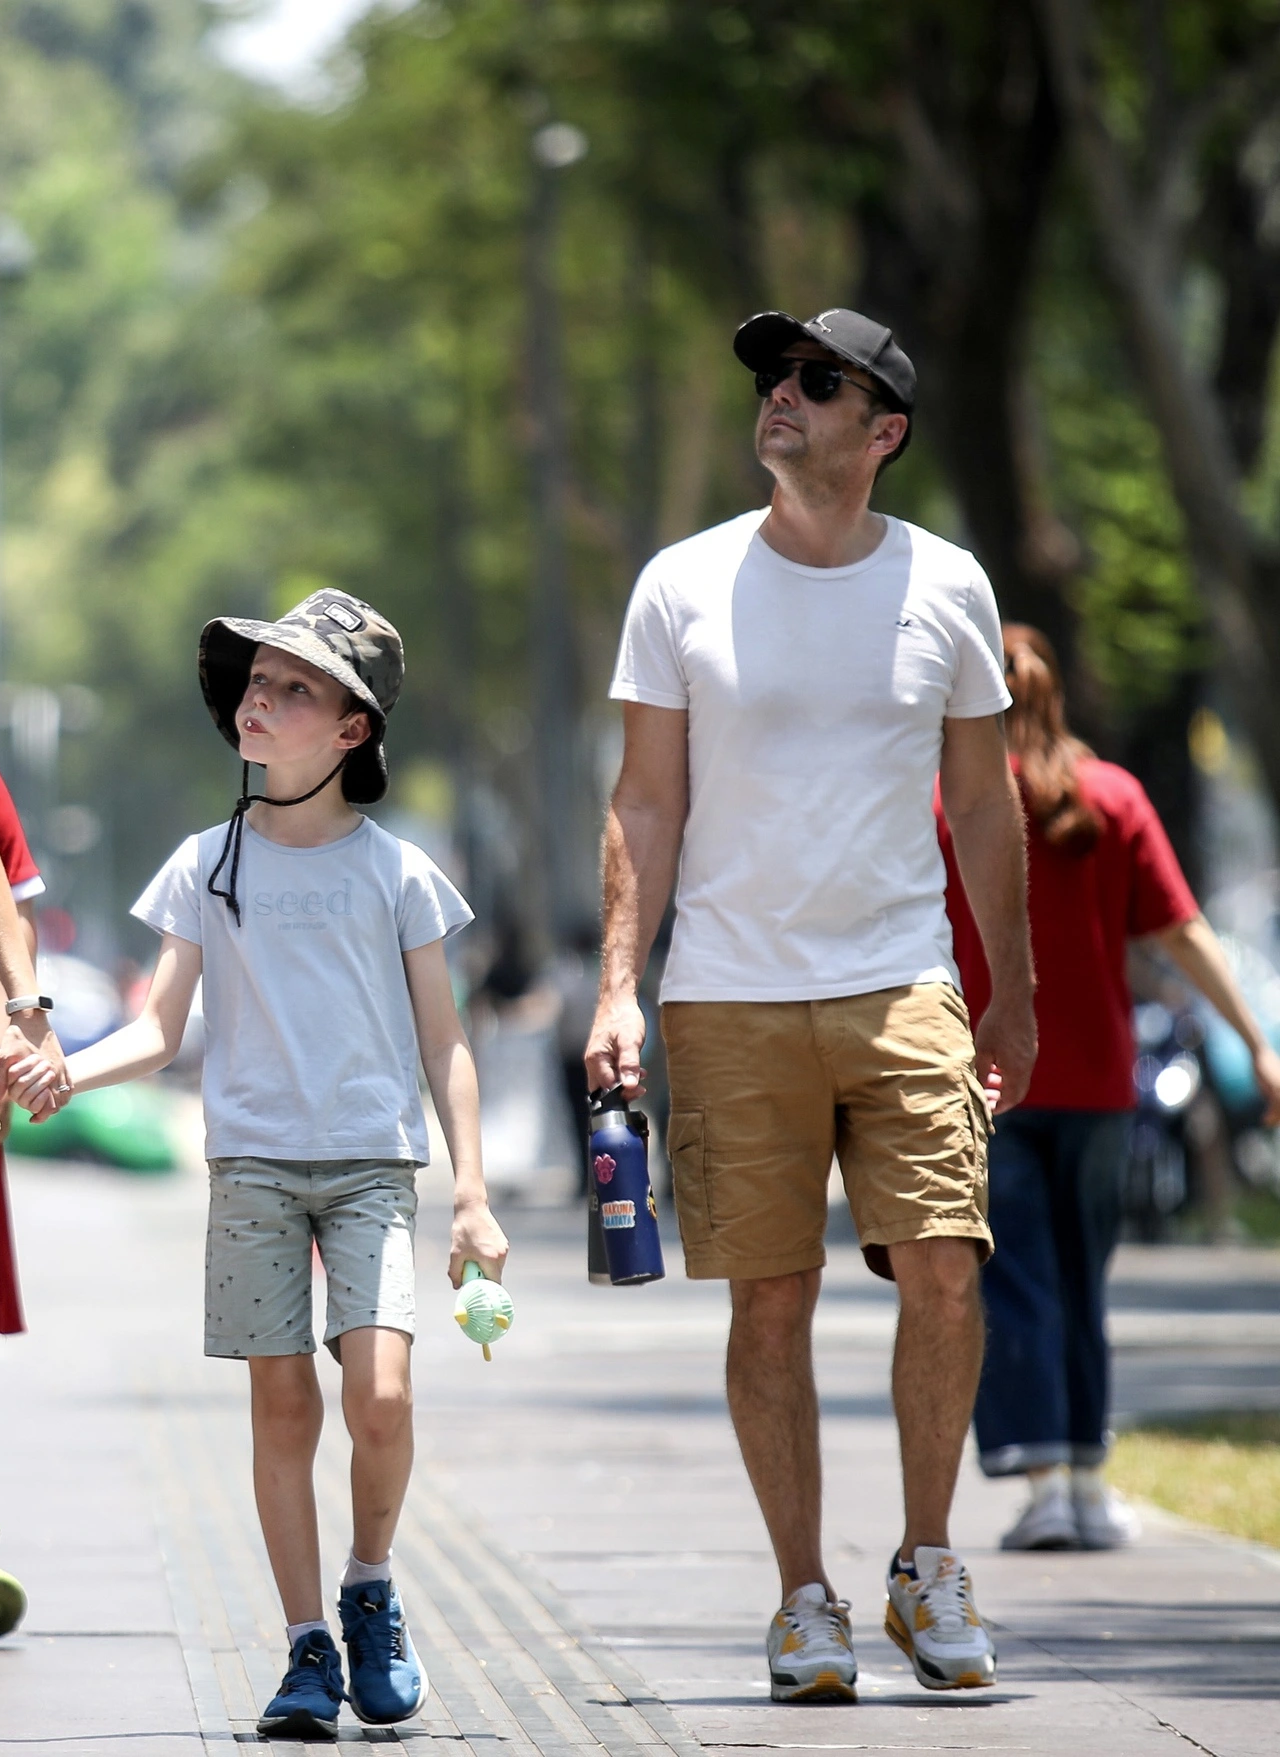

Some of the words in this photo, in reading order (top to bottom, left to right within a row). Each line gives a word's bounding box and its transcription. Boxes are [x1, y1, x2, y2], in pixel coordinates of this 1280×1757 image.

[254, 878, 352, 916] seed
[604, 1203, 634, 1215] HAKUNA
[605, 1215, 633, 1226] MATATA
